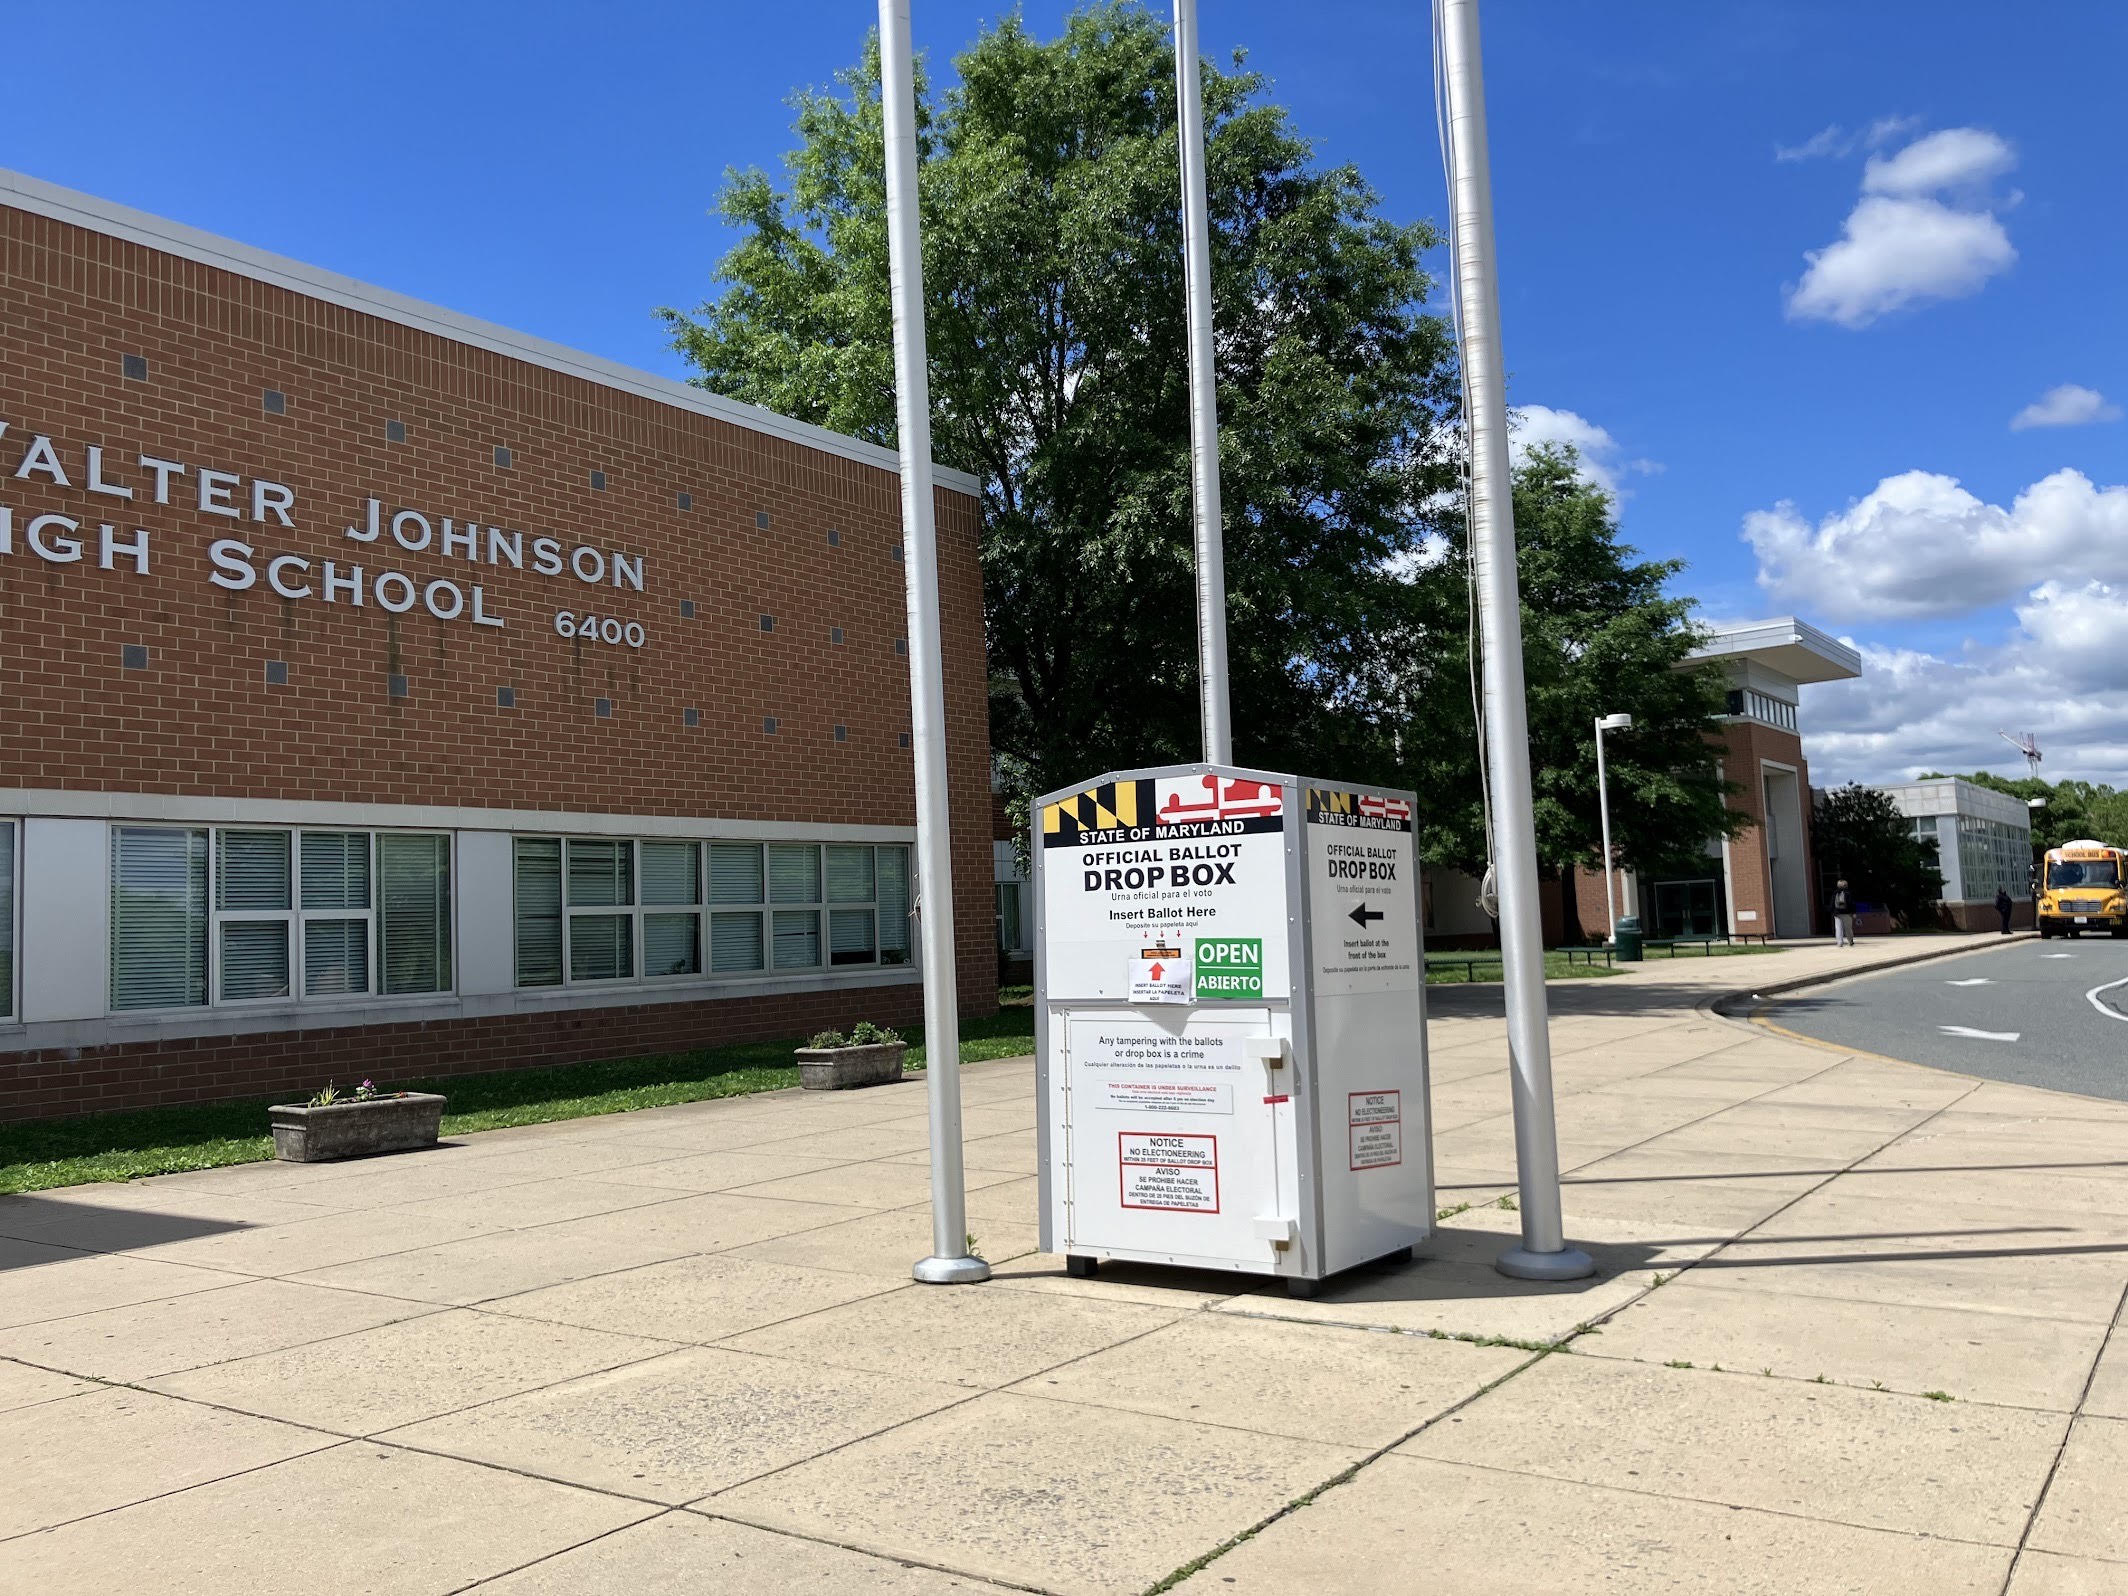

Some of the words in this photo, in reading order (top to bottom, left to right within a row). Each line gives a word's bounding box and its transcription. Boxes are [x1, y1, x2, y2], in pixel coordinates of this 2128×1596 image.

[0, 421, 296, 528] ALTER
[344, 497, 645, 592] JOHNSON
[208, 539, 504, 628] SCHOOL
[554, 610, 645, 648] 6400
[1318, 812, 1345, 825] STATE
[1346, 815, 1358, 826] OF
[1360, 816, 1401, 831] MARYLAND
[1079, 829, 1125, 844] STATE
[1130, 827, 1150, 841] OF
[1155, 820, 1245, 839] MARYLAND
[1083, 850, 1163, 866] OFFICIAL
[1169, 843, 1242, 861] BALLOT
[1327, 844, 1365, 858] OFFICIAL
[1367, 847, 1396, 860] BALLOT
[1328, 859, 1367, 879] DROP
[1369, 862, 1396, 880] BOX
[1084, 866, 1165, 892] DROP
[1171, 862, 1236, 887] BOX
[1111, 892, 1131, 901] Urna
[1133, 890, 1159, 900] oficial
[1161, 890, 1180, 900] para
[1183, 889, 1191, 898] el
[1194, 889, 1213, 897] voto
[1336, 884, 1348, 893] Urna
[1349, 884, 1364, 894] oficial
[1365, 886, 1375, 895] para
[1381, 886, 1391, 894] voto
[1109, 909, 1144, 920] Insert
[1147, 907, 1183, 919] Ballot
[1187, 906, 1216, 917] Here
[1126, 922, 1150, 930] Deposite
[1160, 921, 1184, 929] papeleta
[1360, 939, 1374, 947] ballot
[1381, 939, 1389, 947] the
[1198, 943, 1258, 964] OPEN
[1348, 951, 1360, 959] front
[1361, 951, 1367, 959] of
[1367, 951, 1376, 959] the
[1377, 950, 1386, 958] box
[1197, 975, 1261, 990] ABIERTO
[1099, 1036, 1114, 1046] Any
[1116, 1036, 1161, 1047] tampering
[1160, 1036, 1177, 1046] with
[1179, 1037, 1192, 1046] the
[1194, 1037, 1223, 1046] ballots
[1125, 1049, 1144, 1059] drop
[1146, 1050, 1161, 1058] box
[1164, 1050, 1171, 1058] is
[1180, 1050, 1204, 1059] crime
[1366, 1095, 1384, 1105] NOTICE
[1150, 1137, 1184, 1147] NOTICE
[1142, 1149, 1205, 1158] ELECTIONEERING
[1155, 1167, 1180, 1175] AVISO
[1166, 1186, 1202, 1194] ELECTORAL
